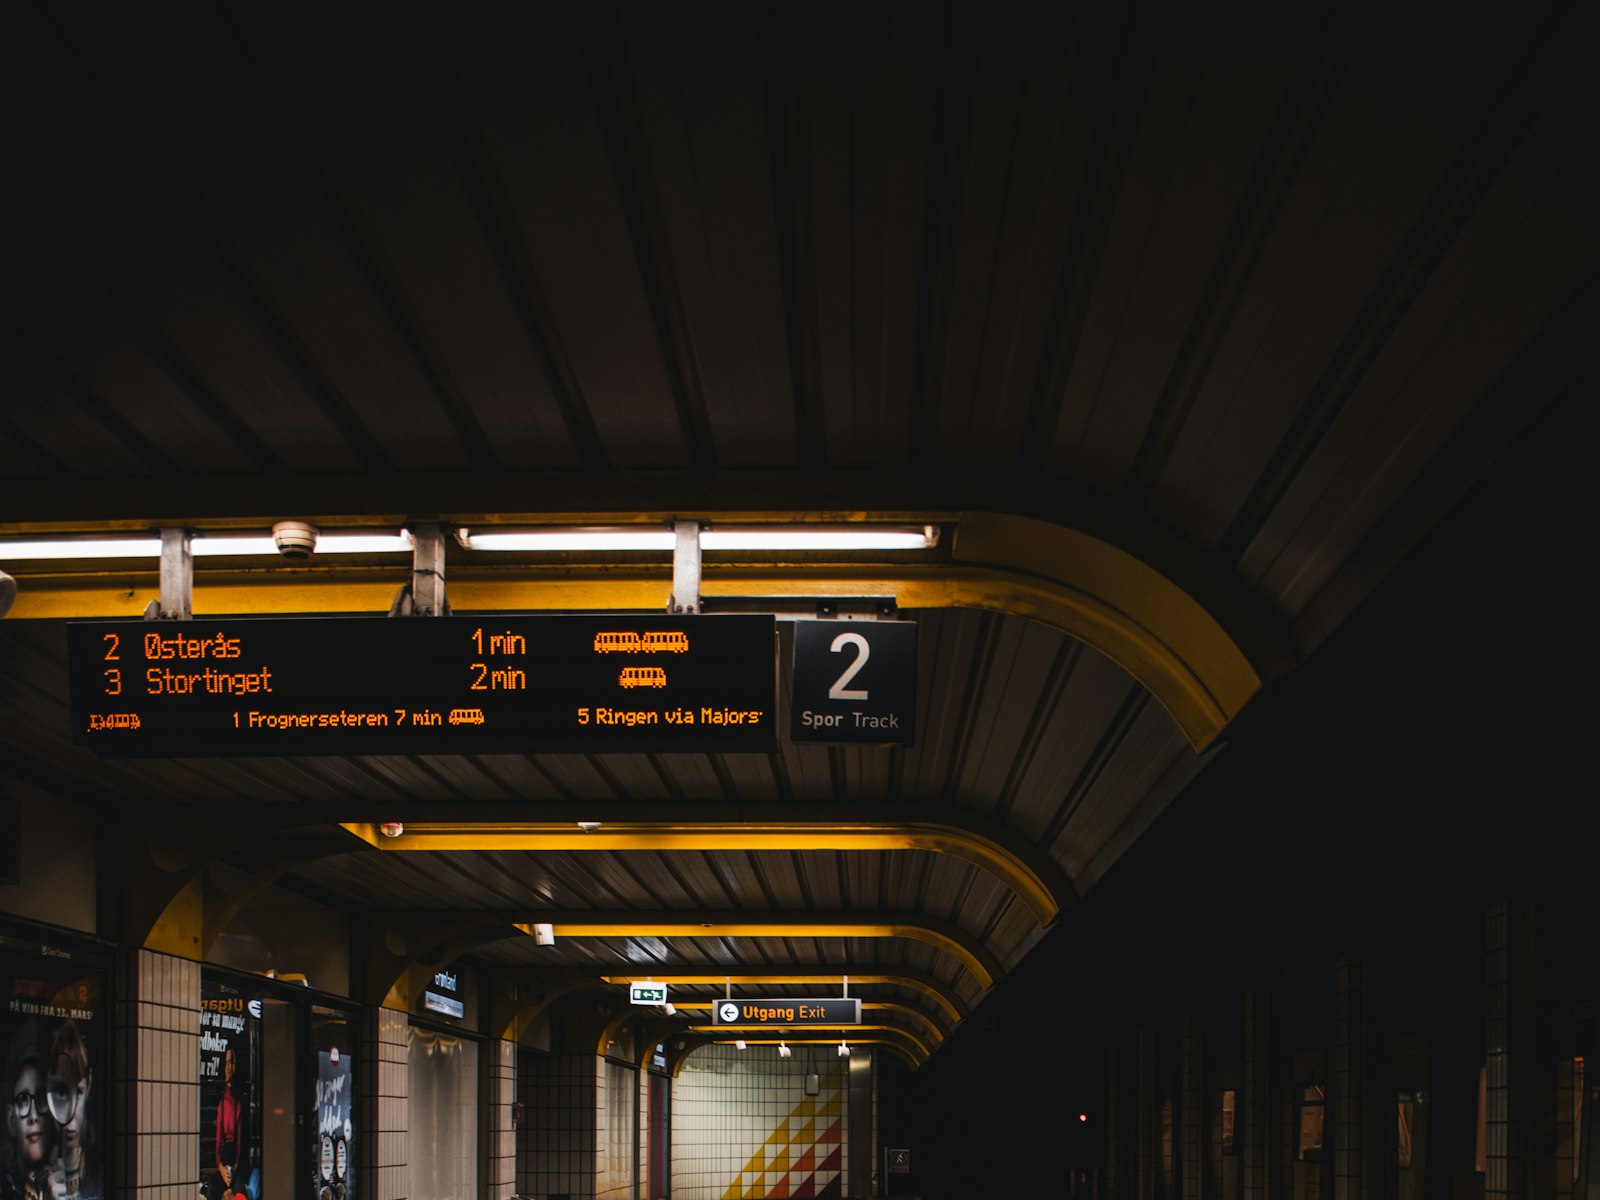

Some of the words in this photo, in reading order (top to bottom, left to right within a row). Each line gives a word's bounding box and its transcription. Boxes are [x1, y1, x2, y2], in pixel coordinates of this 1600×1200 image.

[104, 634, 121, 660] 2
[144, 632, 241, 660] Østerås
[829, 632, 870, 700] 2
[104, 668, 121, 695] 3
[146, 666, 272, 696] Stortinget
[233, 711, 239, 728] 1
[249, 710, 388, 729] Frognerseteren
[394, 709, 406, 726] 7
[413, 709, 442, 726] min
[578, 708, 590, 725] 5
[596, 708, 658, 727] Ringen
[665, 708, 694, 725] via
[701, 708, 763, 727] Majors
[802, 711, 843, 728] Spor
[852, 712, 898, 728] Track
[22, 1002, 39, 1015] KINO
[40, 1004, 55, 1017] FRA
[743, 1005, 794, 1021] Utgang
[799, 1005, 825, 1018] Exit
